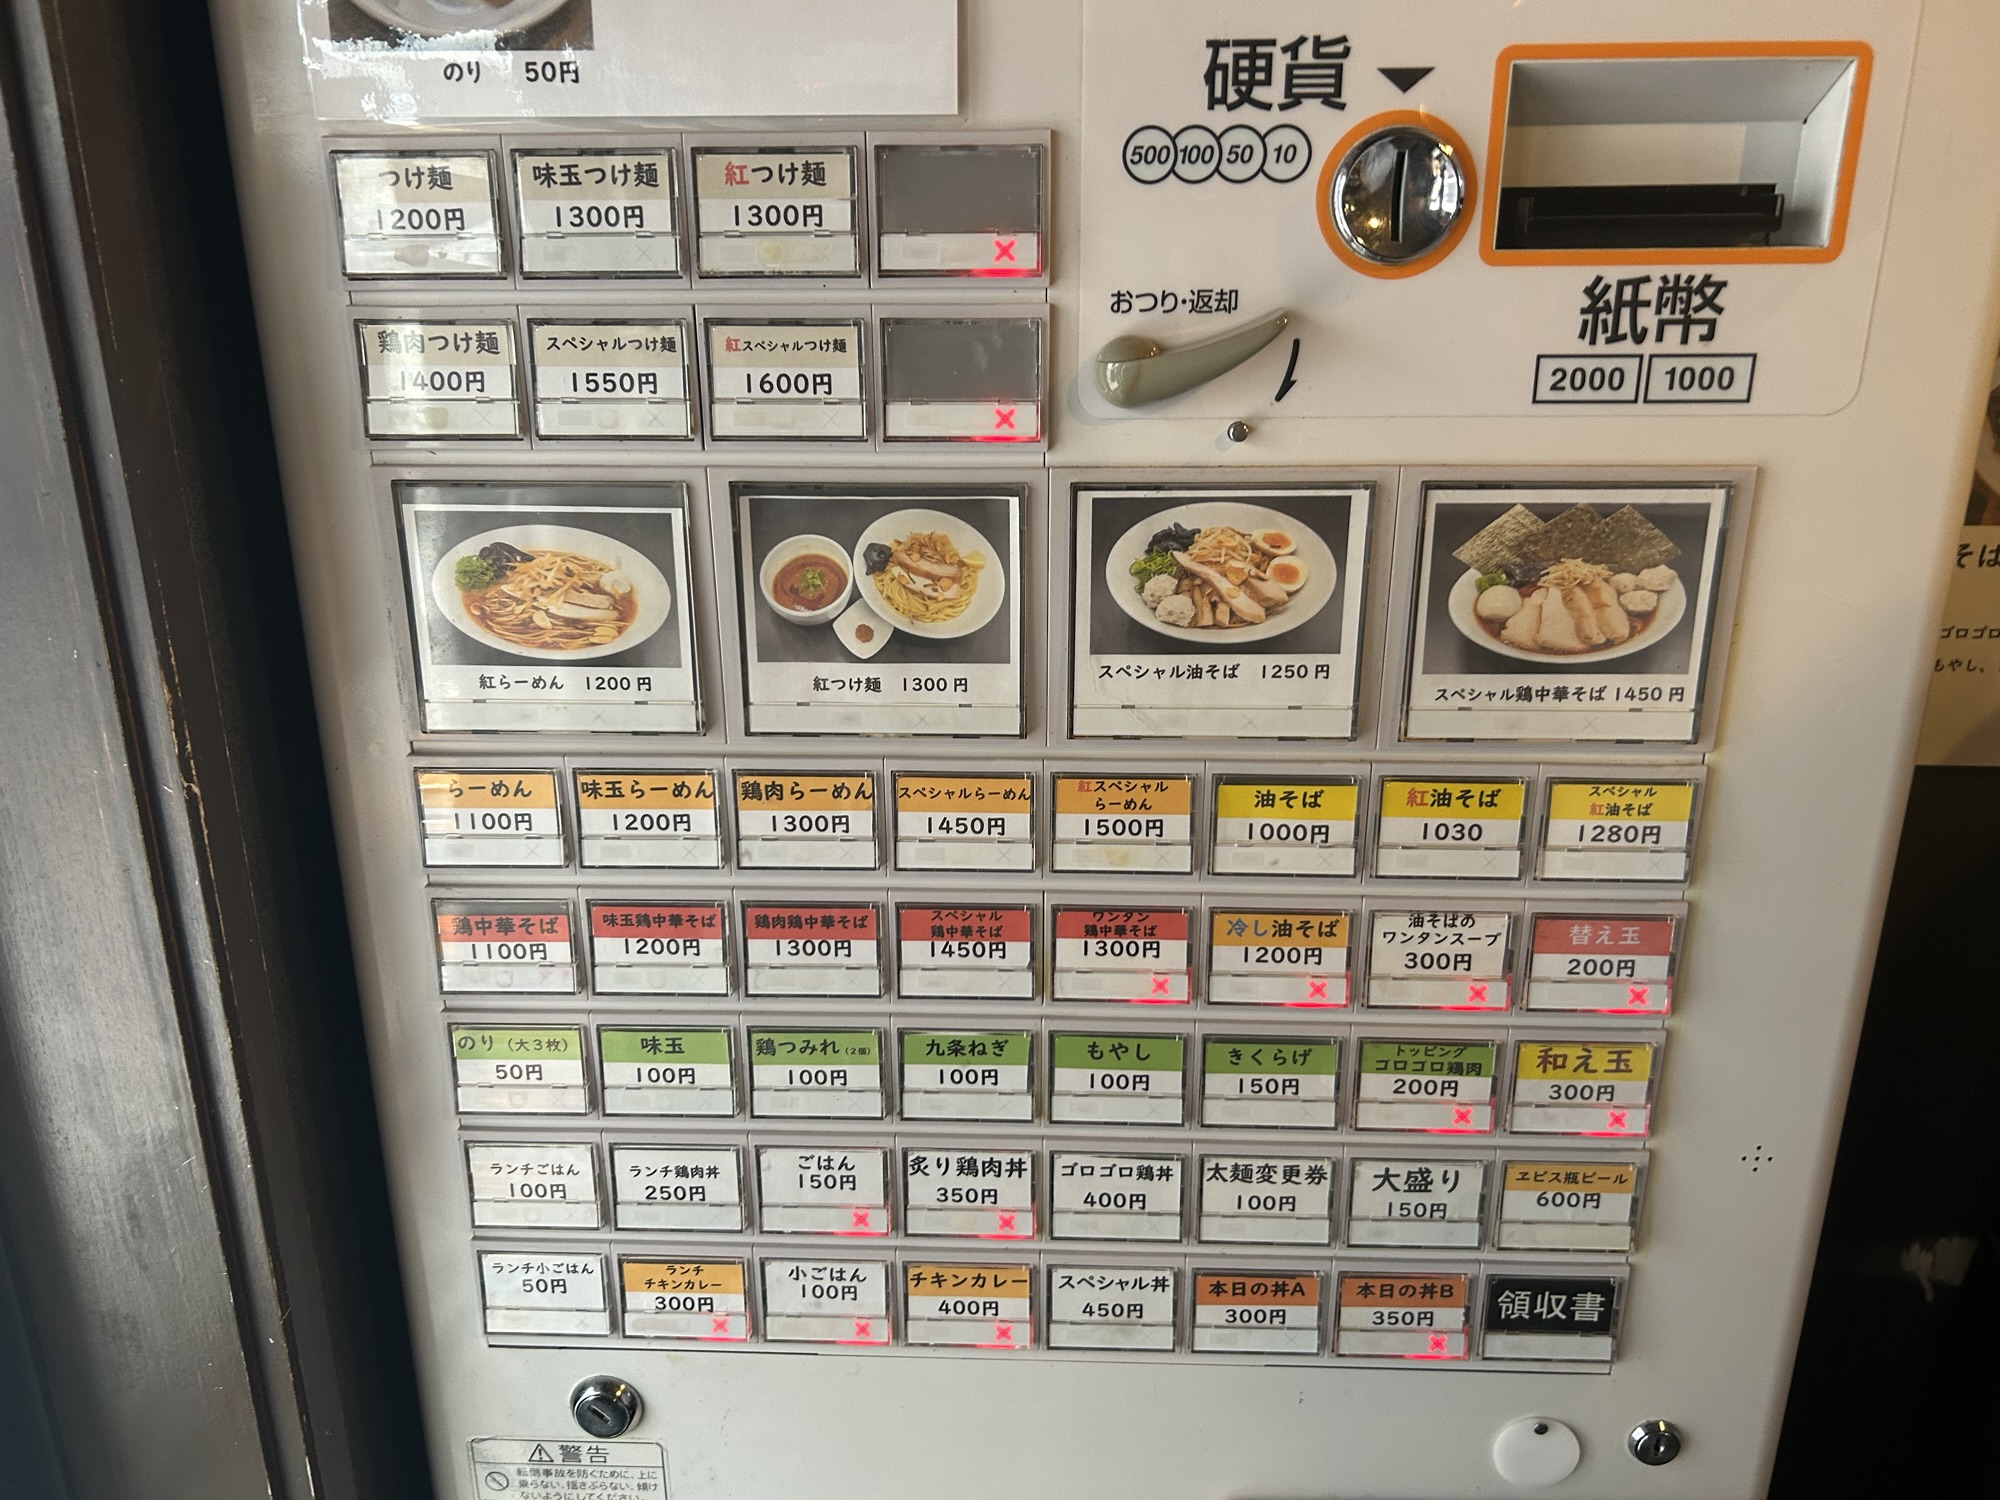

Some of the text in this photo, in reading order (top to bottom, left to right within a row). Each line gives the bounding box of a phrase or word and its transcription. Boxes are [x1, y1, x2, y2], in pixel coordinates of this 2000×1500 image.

[443, 61, 580, 84] のり 50円
[1203, 34, 1352, 111] 硬貨
[1129, 143, 1298, 166] 500 100 50 10
[379, 165, 453, 190] つけ麺
[533, 163, 660, 188] 味玉つけ麺
[724, 161, 827, 187] 紅つけ麺
[376, 208, 465, 231] 1200円
[555, 205, 645, 228] 1300円
[733, 204, 824, 228] 1300円
[1110, 289, 1239, 315] おつり・返却
[1577, 273, 1728, 346] 紙幣
[377, 330, 501, 355] 鶏肉つけ麺
[546, 336, 677, 353] スペシャルつけ麺
[725, 336, 848, 353] 紅スペシャルつけ麺
[399, 371, 486, 393] 1400円
[571, 371, 659, 395] 1550円
[746, 373, 833, 396] 1600円
[1549, 366, 1734, 391] 2000 1000
[1098, 663, 1239, 681] スペシャル油そば
[478, 674, 565, 691] 紅らーめん
[812, 675, 882, 693] 紅つけ麺
[449, 779, 532, 799] らーめん
[581, 779, 715, 799] 味玉らーめん
[741, 781, 873, 801] 鶏肉らーめん
[898, 786, 1031, 801] スペシャルらーめん
[1078, 779, 1169, 794] 紅スペシャル
[1589, 786, 1657, 797] スペシャル
[1096, 797, 1152, 811] らーめん
[1254, 789, 1325, 809] 油そば
[1406, 788, 1501, 808] 紅油そば
[1589, 802, 1653, 817] 紅油そば
[454, 812, 533, 832] 1100円
[613, 813, 691, 832] 1200円
[772, 814, 850, 833] 1300円
[927, 817, 1006, 836] 1450円
[1084, 818, 1164, 838] 1500円
[1248, 823, 1330, 843] 1000円
[1422, 822, 1483, 841] 1030
[1578, 824, 1662, 844] 1280円
[603, 913, 716, 928] 味玉鶏中華そば
[755, 914, 868, 930] 鶏肉鶏中華そば
[931, 910, 1003, 922] スペシャル
[1408, 913, 1475, 929] 油そばの
[452, 916, 559, 936] 鶏中華そば
[931, 925, 1003, 938] 鶏中華そば
[1084, 924, 1158, 938] 鶏中華そば
[1226, 919, 1340, 938] 冷し油そば
[1569, 925, 1641, 945] 替え玉
[625, 938, 701, 956] 1200円
[1382, 931, 1502, 946] ワンタンスープ
[472, 943, 548, 960] 1100円
[776, 939, 852, 958] 1300円
[930, 941, 1006, 960] 1450円
[1083, 940, 1161, 959] 1300円
[1244, 946, 1323, 965] 1200円
[1404, 952, 1473, 972] 300円
[1567, 959, 1636, 978] 200円
[641, 1037, 685, 1054] 味玉
[926, 1039, 1010, 1058] 九条ねぎ
[1087, 1041, 1151, 1061] もやし
[1395, 1045, 1468, 1058] トッピング
[1228, 1048, 1313, 1066] きくらげ
[1536, 1047, 1633, 1074] 和え玉
[496, 1063, 544, 1081] 50円
[636, 1067, 696, 1085] 100円
[1375, 1058, 1482, 1076] ゴロゴロ鶏肉
[788, 1069, 848, 1087] 100円
[939, 1068, 999, 1086] 100円
[1089, 1073, 1150, 1092] 100円
[1238, 1078, 1300, 1096] 150円
[1393, 1079, 1459, 1098] 200円
[1549, 1084, 1615, 1102] 300円
[490, 1163, 580, 1177] ランチごはん
[629, 1165, 721, 1179] ランチ鶏肉丼
[798, 1155, 856, 1171] ごはん
[909, 1156, 1028, 1178] 炙り鶏肉丼
[1061, 1162, 1174, 1182] ゴロゴロ鶏丼
[799, 1174, 857, 1191] 150円
[1205, 1162, 1328, 1186] 太麺変更券
[1372, 1167, 1460, 1194] 大盛り
[510, 1183, 567, 1200] 100円
[645, 1185, 706, 1202] 250円
[936, 1188, 999, 1205] 350円
[1536, 1191, 1601, 1209] 600円
[1083, 1192, 1147, 1210] 400円
[1236, 1195, 1296, 1212] 100円
[1388, 1202, 1447, 1220] 150円
[492, 1262, 594, 1275] ランチ小ごはん
[666, 1265, 704, 1276] ランチ
[788, 1266, 867, 1283] 小ごはん
[522, 1278, 568, 1294] 50円
[644, 1278, 722, 1290] チキンカレー
[910, 1271, 1028, 1288] チキンカレー
[1058, 1275, 1170, 1293] スペシャル丼
[801, 1284, 858, 1301] 100円
[1209, 1280, 1305, 1298] 本日の丼A
[1356, 1282, 1454, 1299] 本日の丼B
[655, 1296, 714, 1312] 300円
[938, 1300, 999, 1317] 400円
[1081, 1302, 1144, 1319] 450円
[1497, 1289, 1605, 1322] 領収書
[1225, 1309, 1286, 1325] 300円
[1372, 1311, 1434, 1326] 350円
[558, 1444, 610, 1463] 警告
